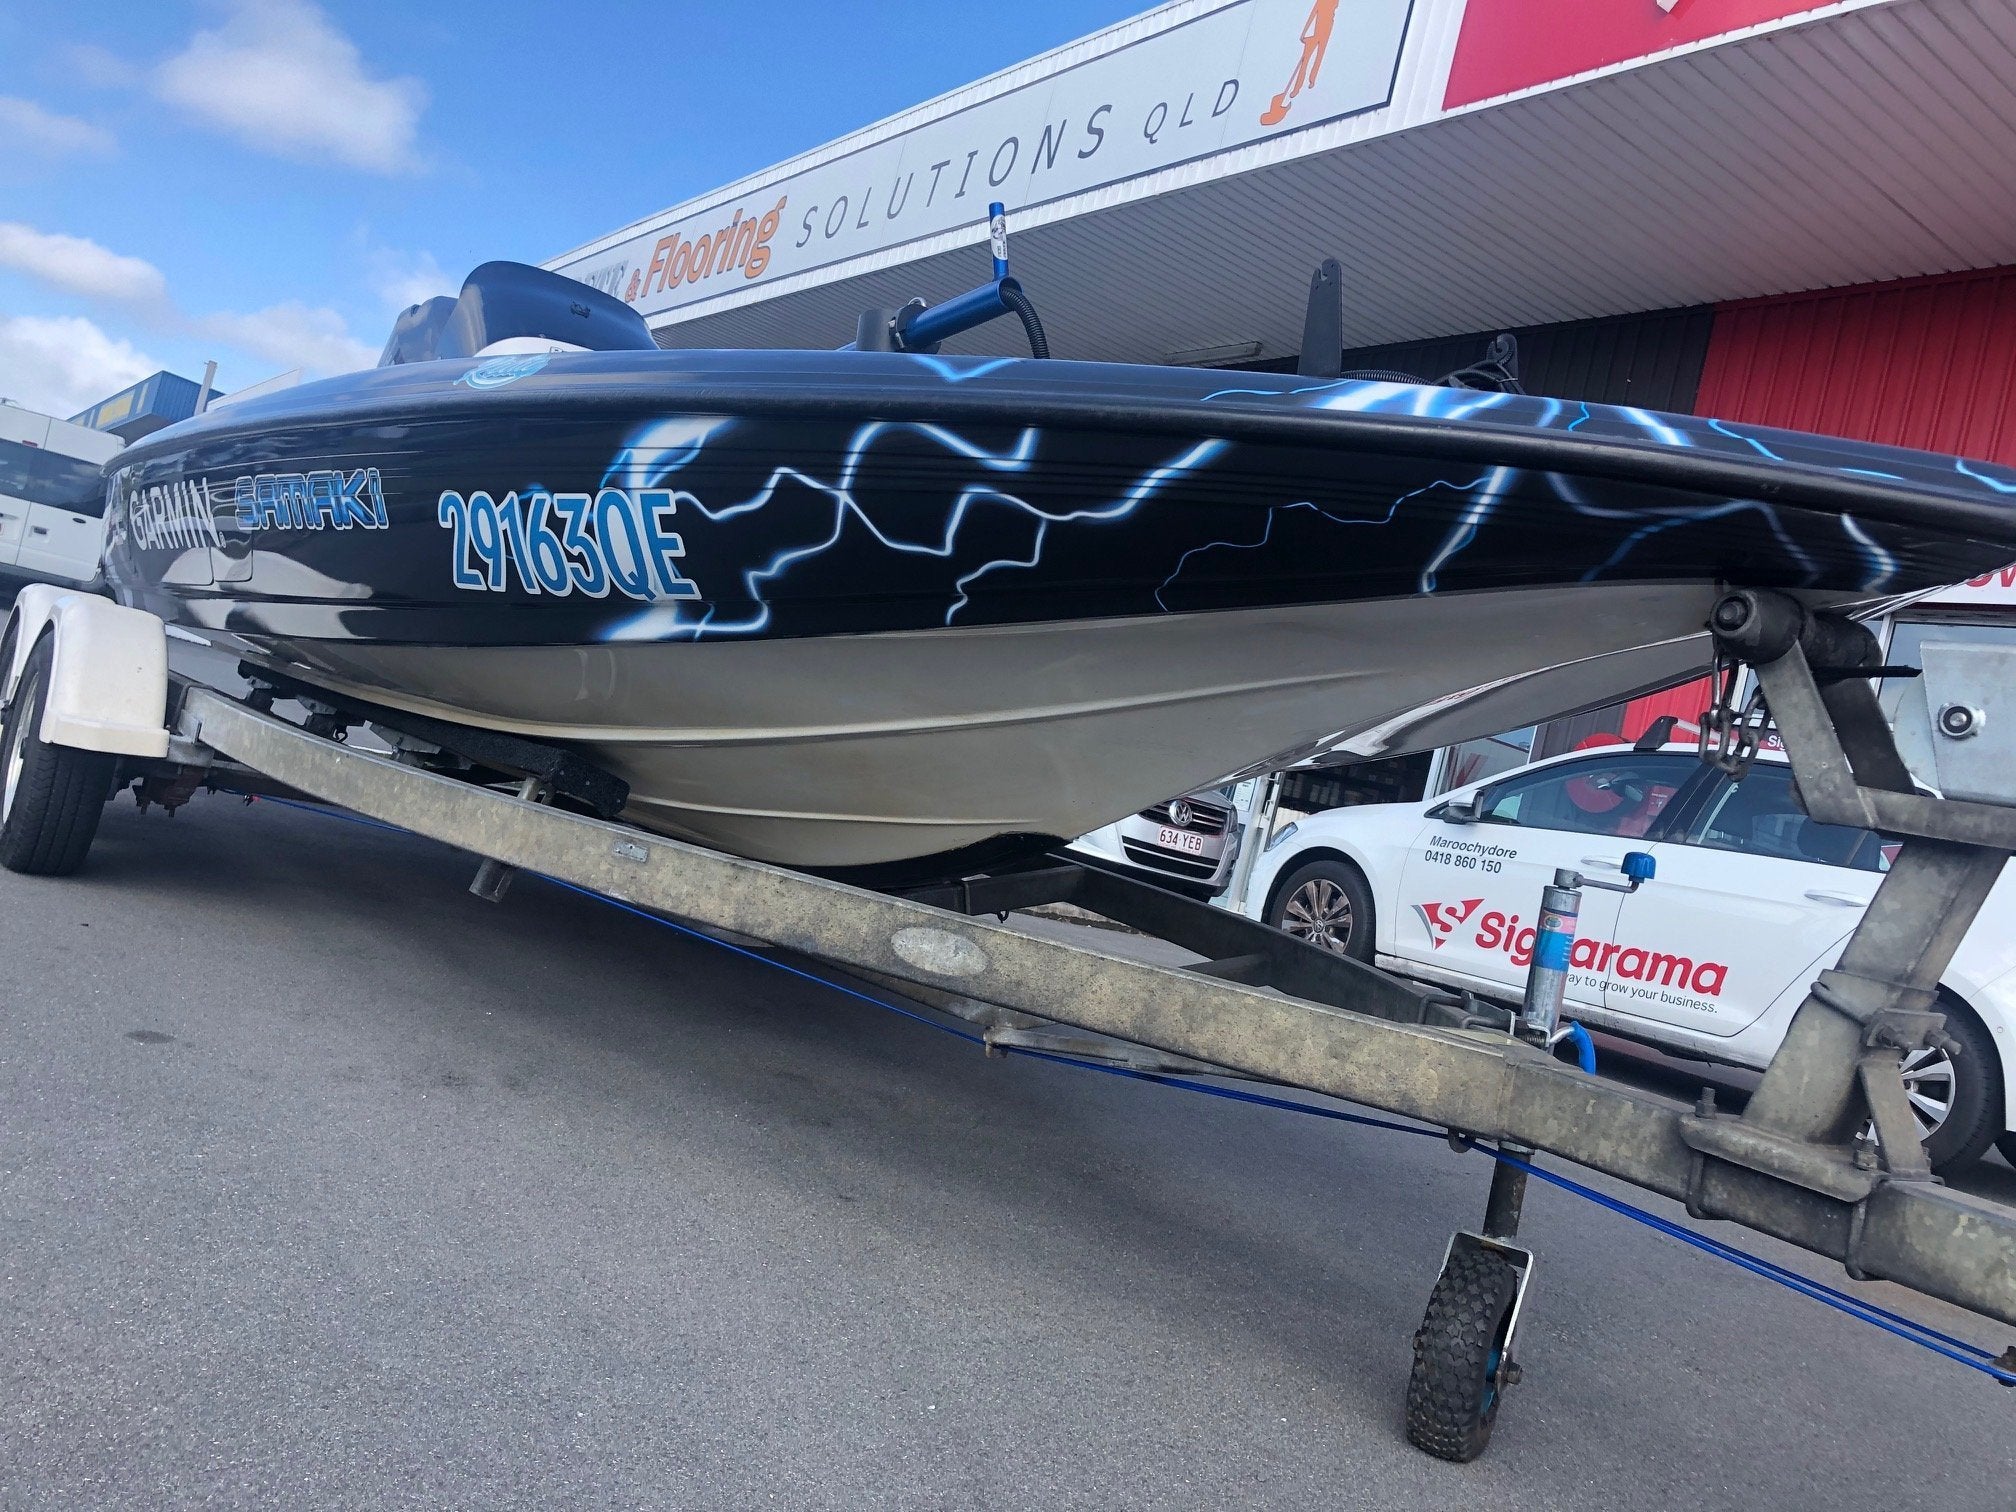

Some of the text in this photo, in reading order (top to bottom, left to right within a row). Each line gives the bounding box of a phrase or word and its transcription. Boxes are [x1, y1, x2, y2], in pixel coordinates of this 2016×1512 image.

[641, 195, 787, 298] Flooring
[795, 103, 1113, 248] SOLUTIONS
[1143, 78, 1240, 144] QLD
[129, 467, 389, 551] GARMIN SAMAKI
[438, 489, 702, 603] 29163QE
[1425, 850, 1502, 874] 0418 860 150
[1429, 835, 1518, 858] Maroochydore
[1475, 911, 1729, 997] Sigarama
[1567, 973, 1718, 1014] ay to grow your business.
